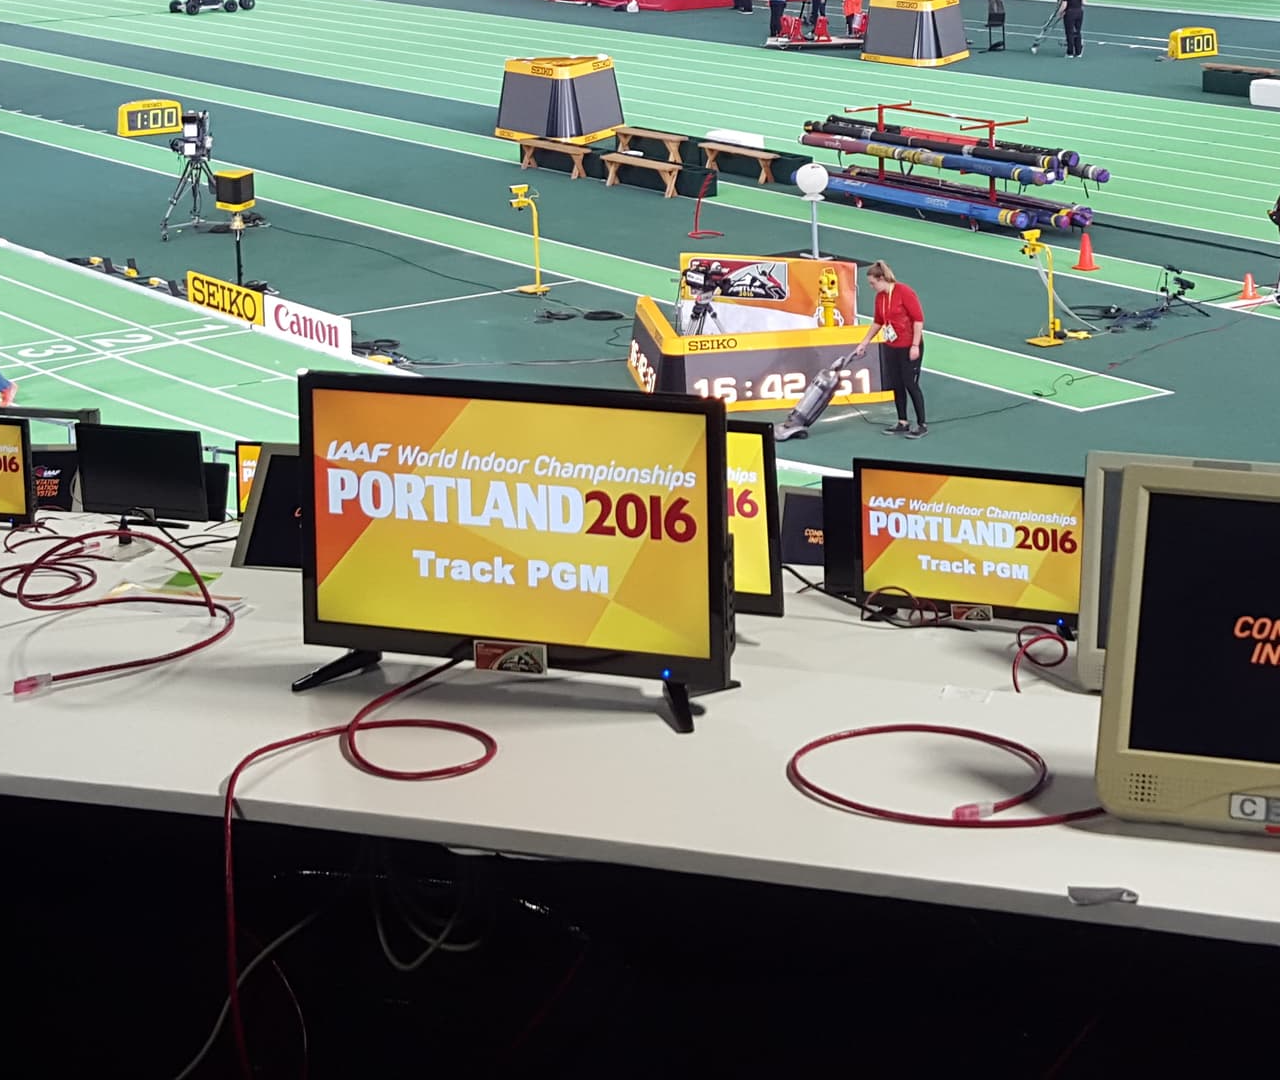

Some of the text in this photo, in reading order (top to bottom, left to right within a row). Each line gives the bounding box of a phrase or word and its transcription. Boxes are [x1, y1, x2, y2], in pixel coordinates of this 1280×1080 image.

[1185, 35, 1213, 52] 1:00
[137, 108, 177, 129] 1:00
[192, 276, 257, 322] SEIKO
[274, 303, 340, 348] Canon
[687, 337, 738, 352] SEIKO
[326, 439, 393, 463] IAAF
[396, 445, 458, 470] World
[462, 449, 529, 475] Indoor
[533, 455, 697, 491] Championships
[868, 494, 1078, 528] IAAF World Indoor Championships
[412, 549, 610, 595] Track PGM
[917, 554, 1030, 581] Track PGM
[1239, 798, 1257, 817] C
